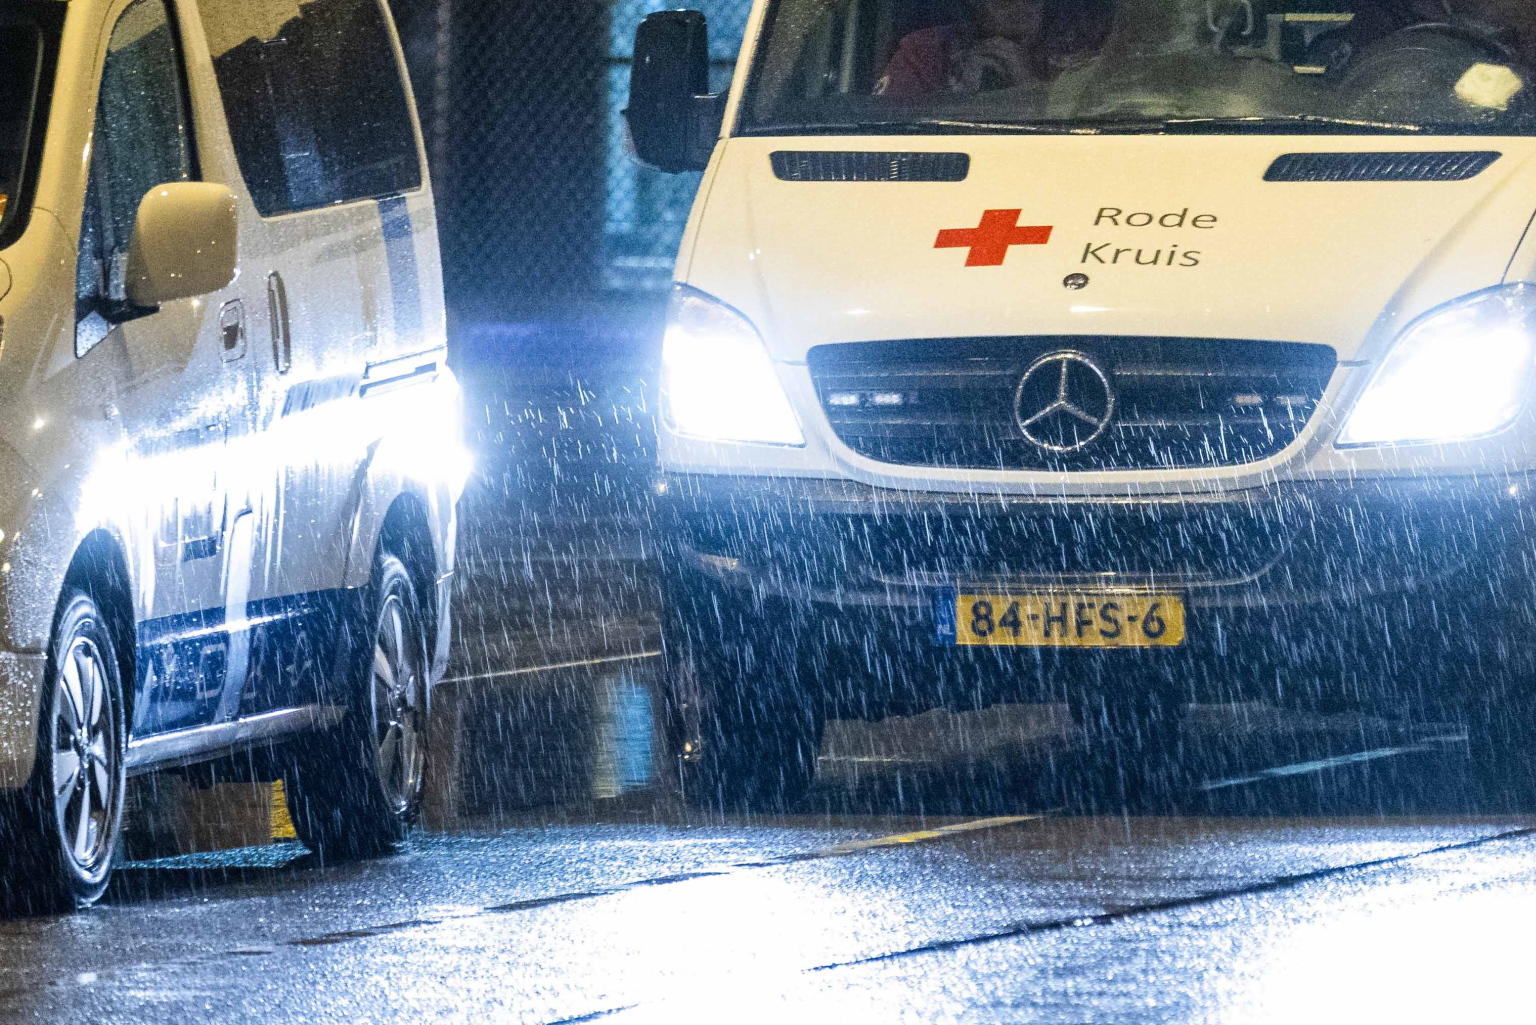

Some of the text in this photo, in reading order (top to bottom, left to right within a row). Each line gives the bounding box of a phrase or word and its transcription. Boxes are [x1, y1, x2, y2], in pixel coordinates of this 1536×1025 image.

[1093, 207, 1217, 229] Rode
[1080, 242, 1201, 267] Kruis
[970, 600, 1167, 639] 84-HFS-6
